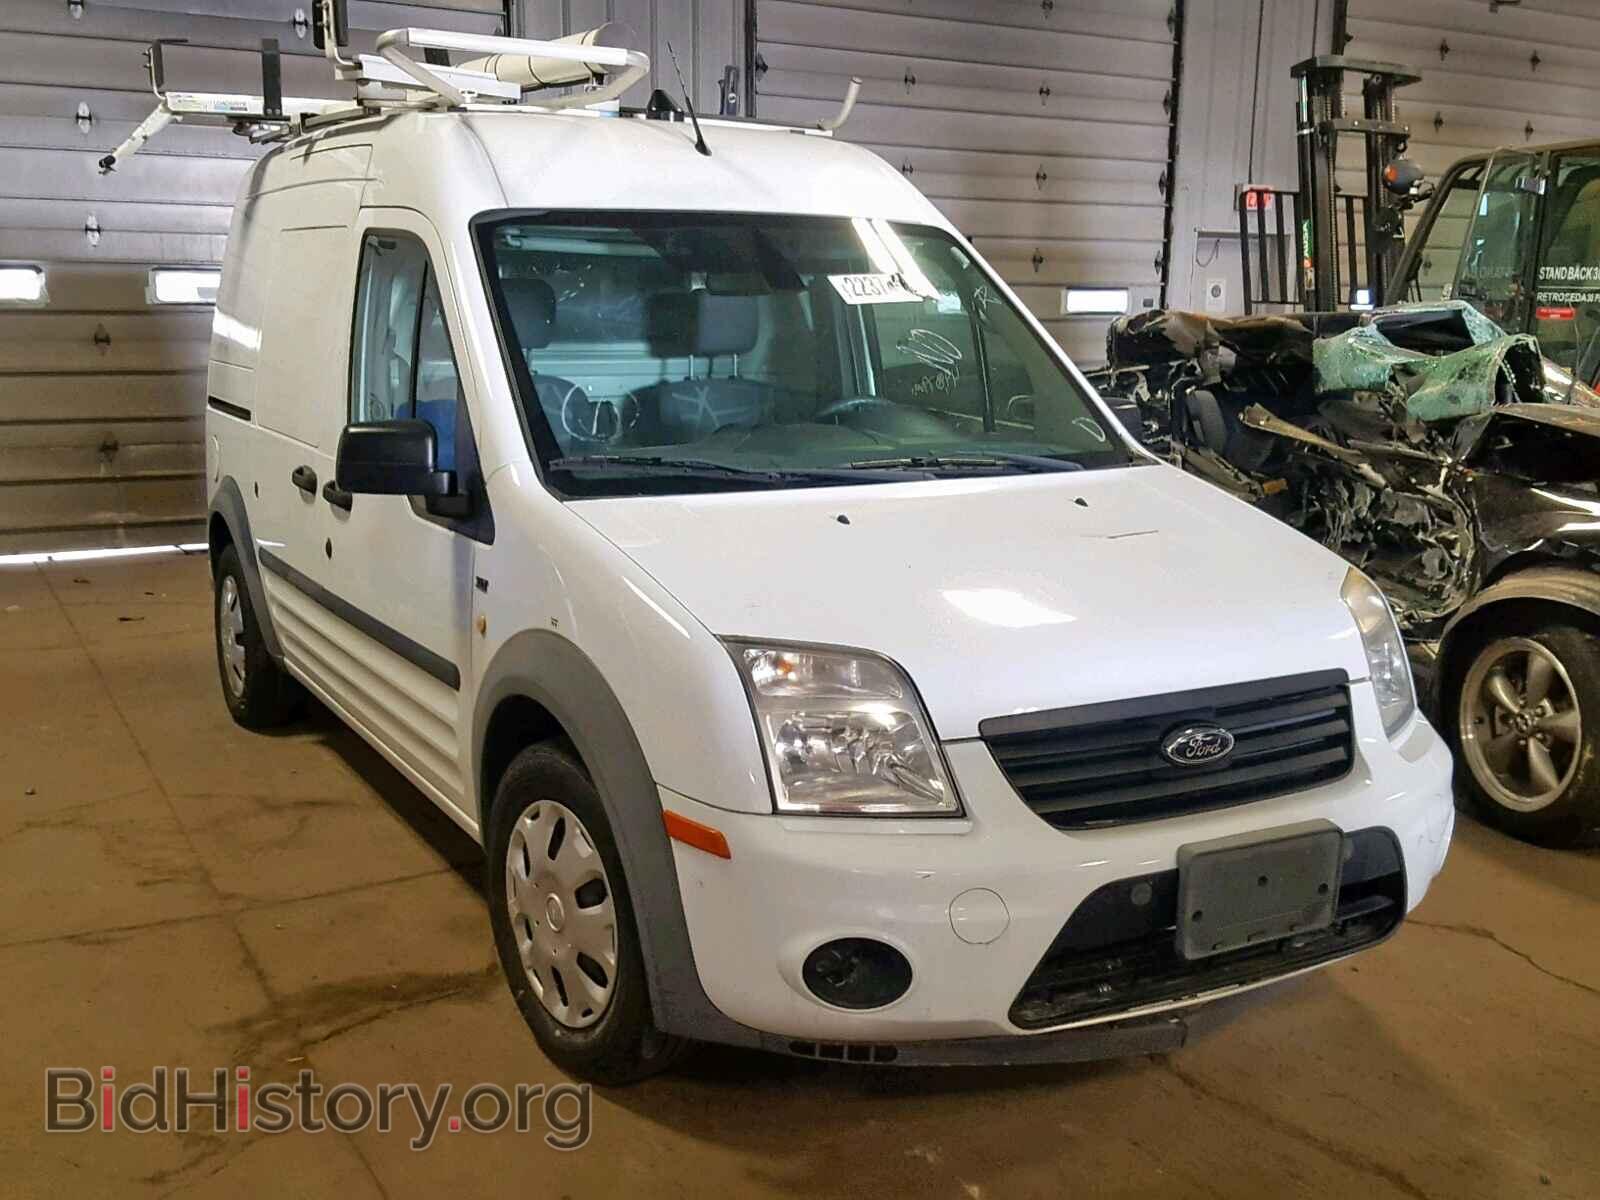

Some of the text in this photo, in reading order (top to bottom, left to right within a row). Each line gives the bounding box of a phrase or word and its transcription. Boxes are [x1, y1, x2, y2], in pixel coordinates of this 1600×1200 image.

[1538, 266, 1567, 280] STAND
[1567, 265, 1592, 280] BACK
[1186, 736, 1221, 758] Ford
